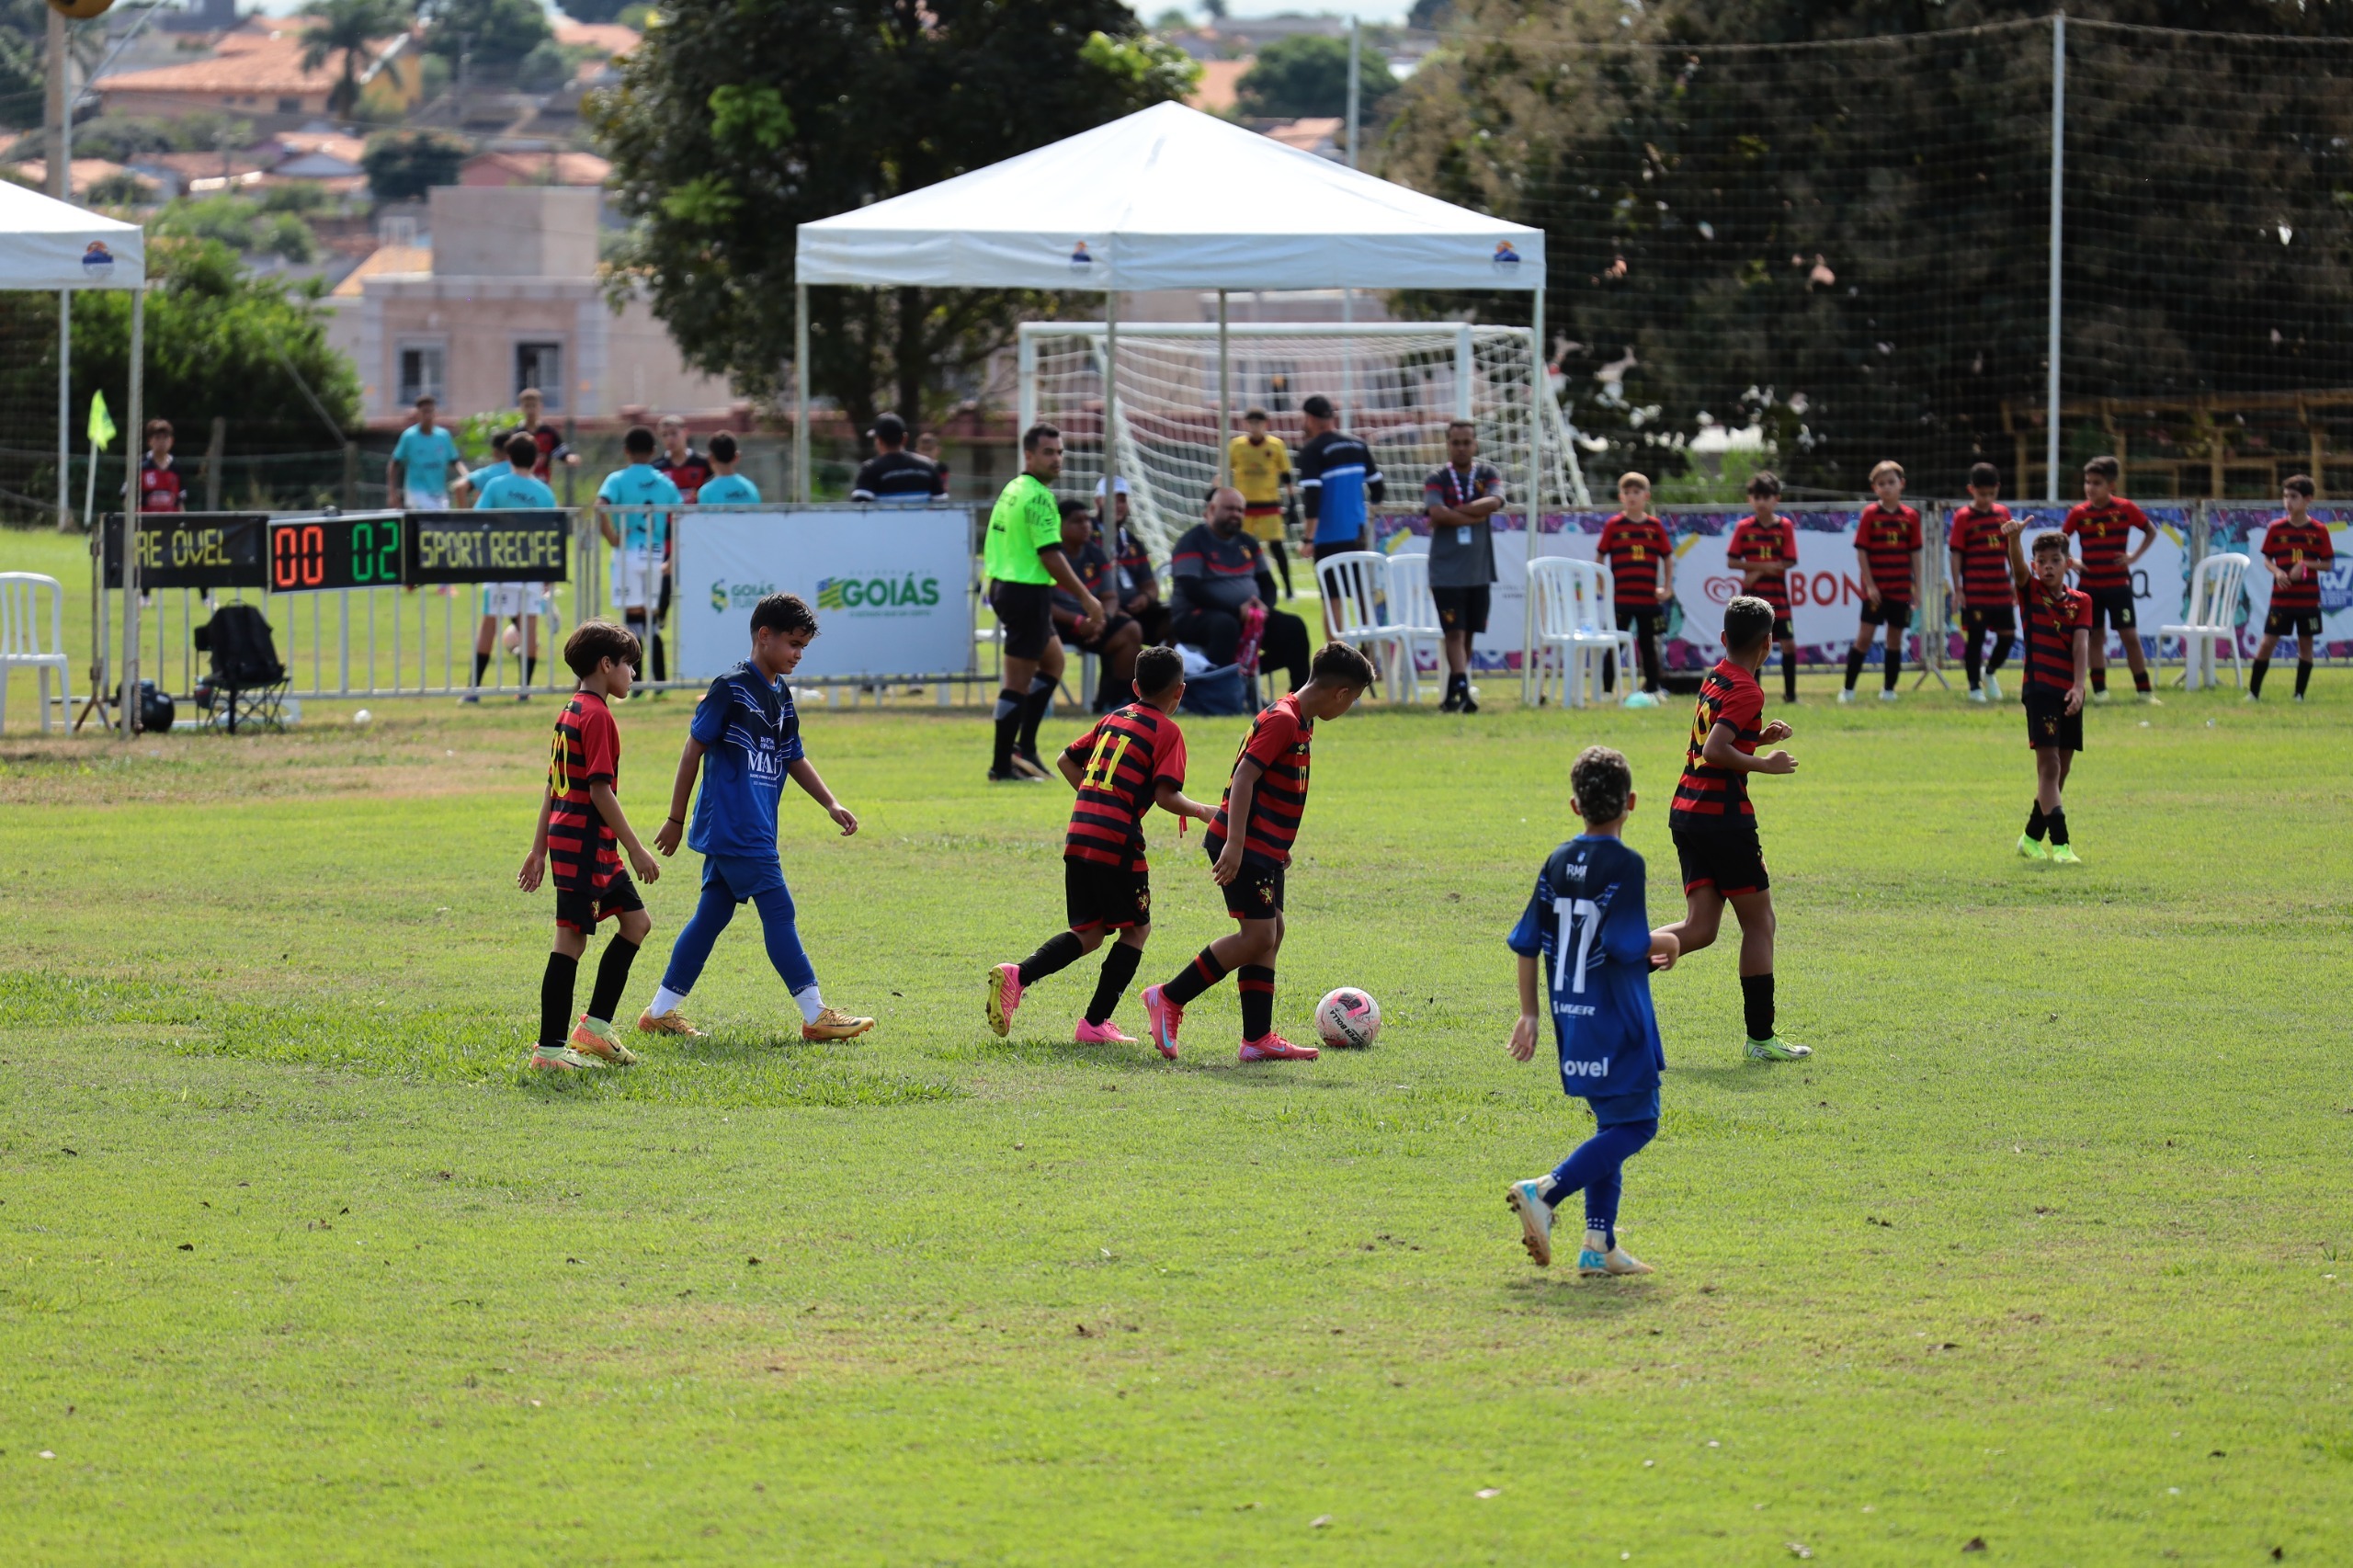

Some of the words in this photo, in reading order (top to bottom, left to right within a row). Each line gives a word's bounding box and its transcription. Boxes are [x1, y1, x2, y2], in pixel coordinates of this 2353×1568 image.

[172, 528, 232, 568] OVEL
[2096, 521, 2106, 538] 3
[276, 525, 324, 588] 00
[352, 521, 399, 582] 02
[419, 530, 483, 569] SPORT
[489, 530, 562, 568] RECIFE
[842, 571, 939, 607] GOIÁS
[1790, 571, 1870, 608] BON
[1083, 731, 1131, 791] 41
[1552, 897, 1601, 994] 17
[1330, 1009, 1347, 1030] BOLLA
[1564, 1057, 1608, 1078] ovel
